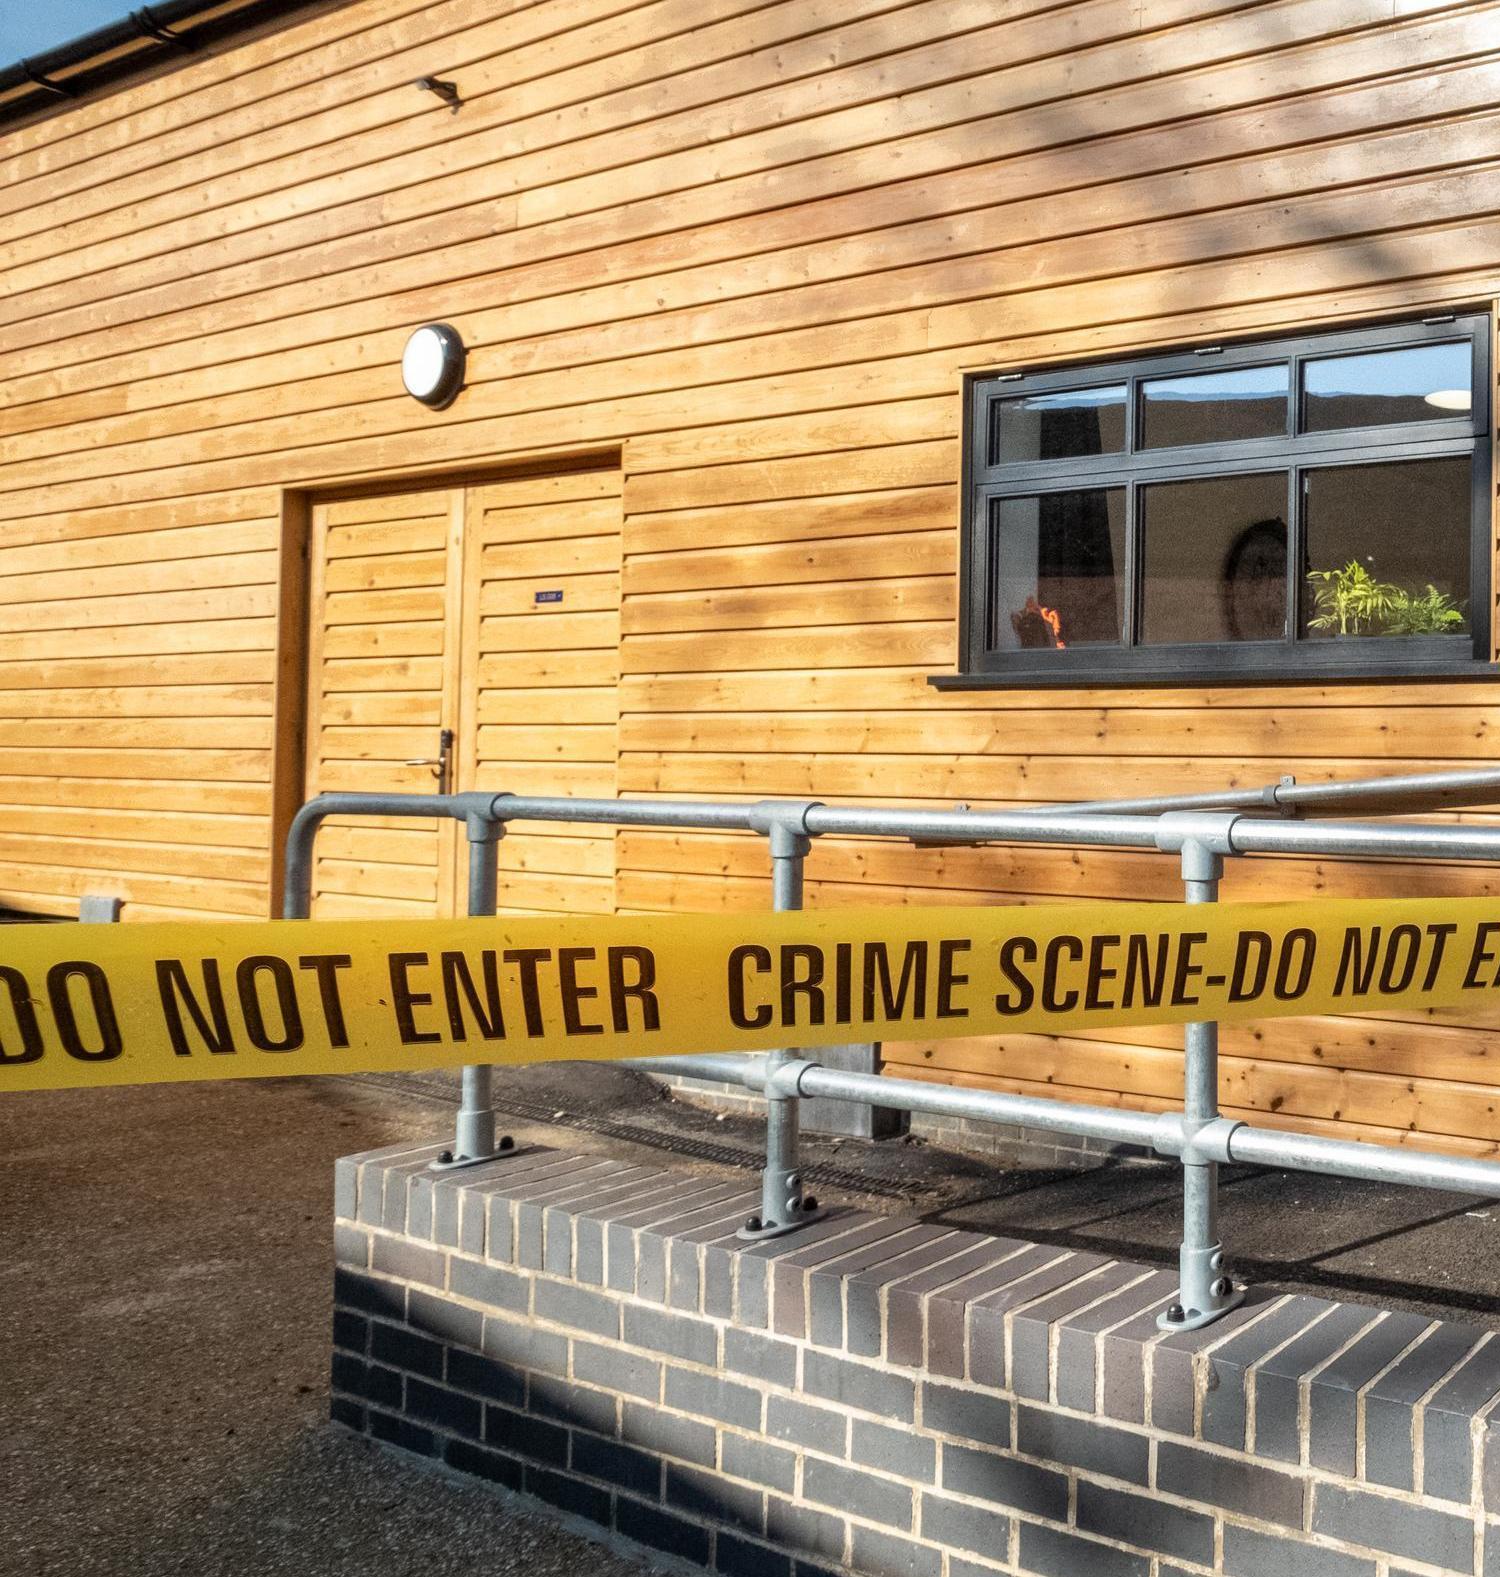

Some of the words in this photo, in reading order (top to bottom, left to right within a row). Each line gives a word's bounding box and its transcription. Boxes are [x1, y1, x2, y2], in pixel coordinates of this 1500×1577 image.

[0, 961, 123, 1064] DO
[154, 954, 352, 1057] NOT
[387, 945, 661, 1046] ENTER
[727, 939, 972, 1030] CRIME
[995, 928, 1317, 1015] SCENE-DO
[1332, 923, 1457, 997] NOT
